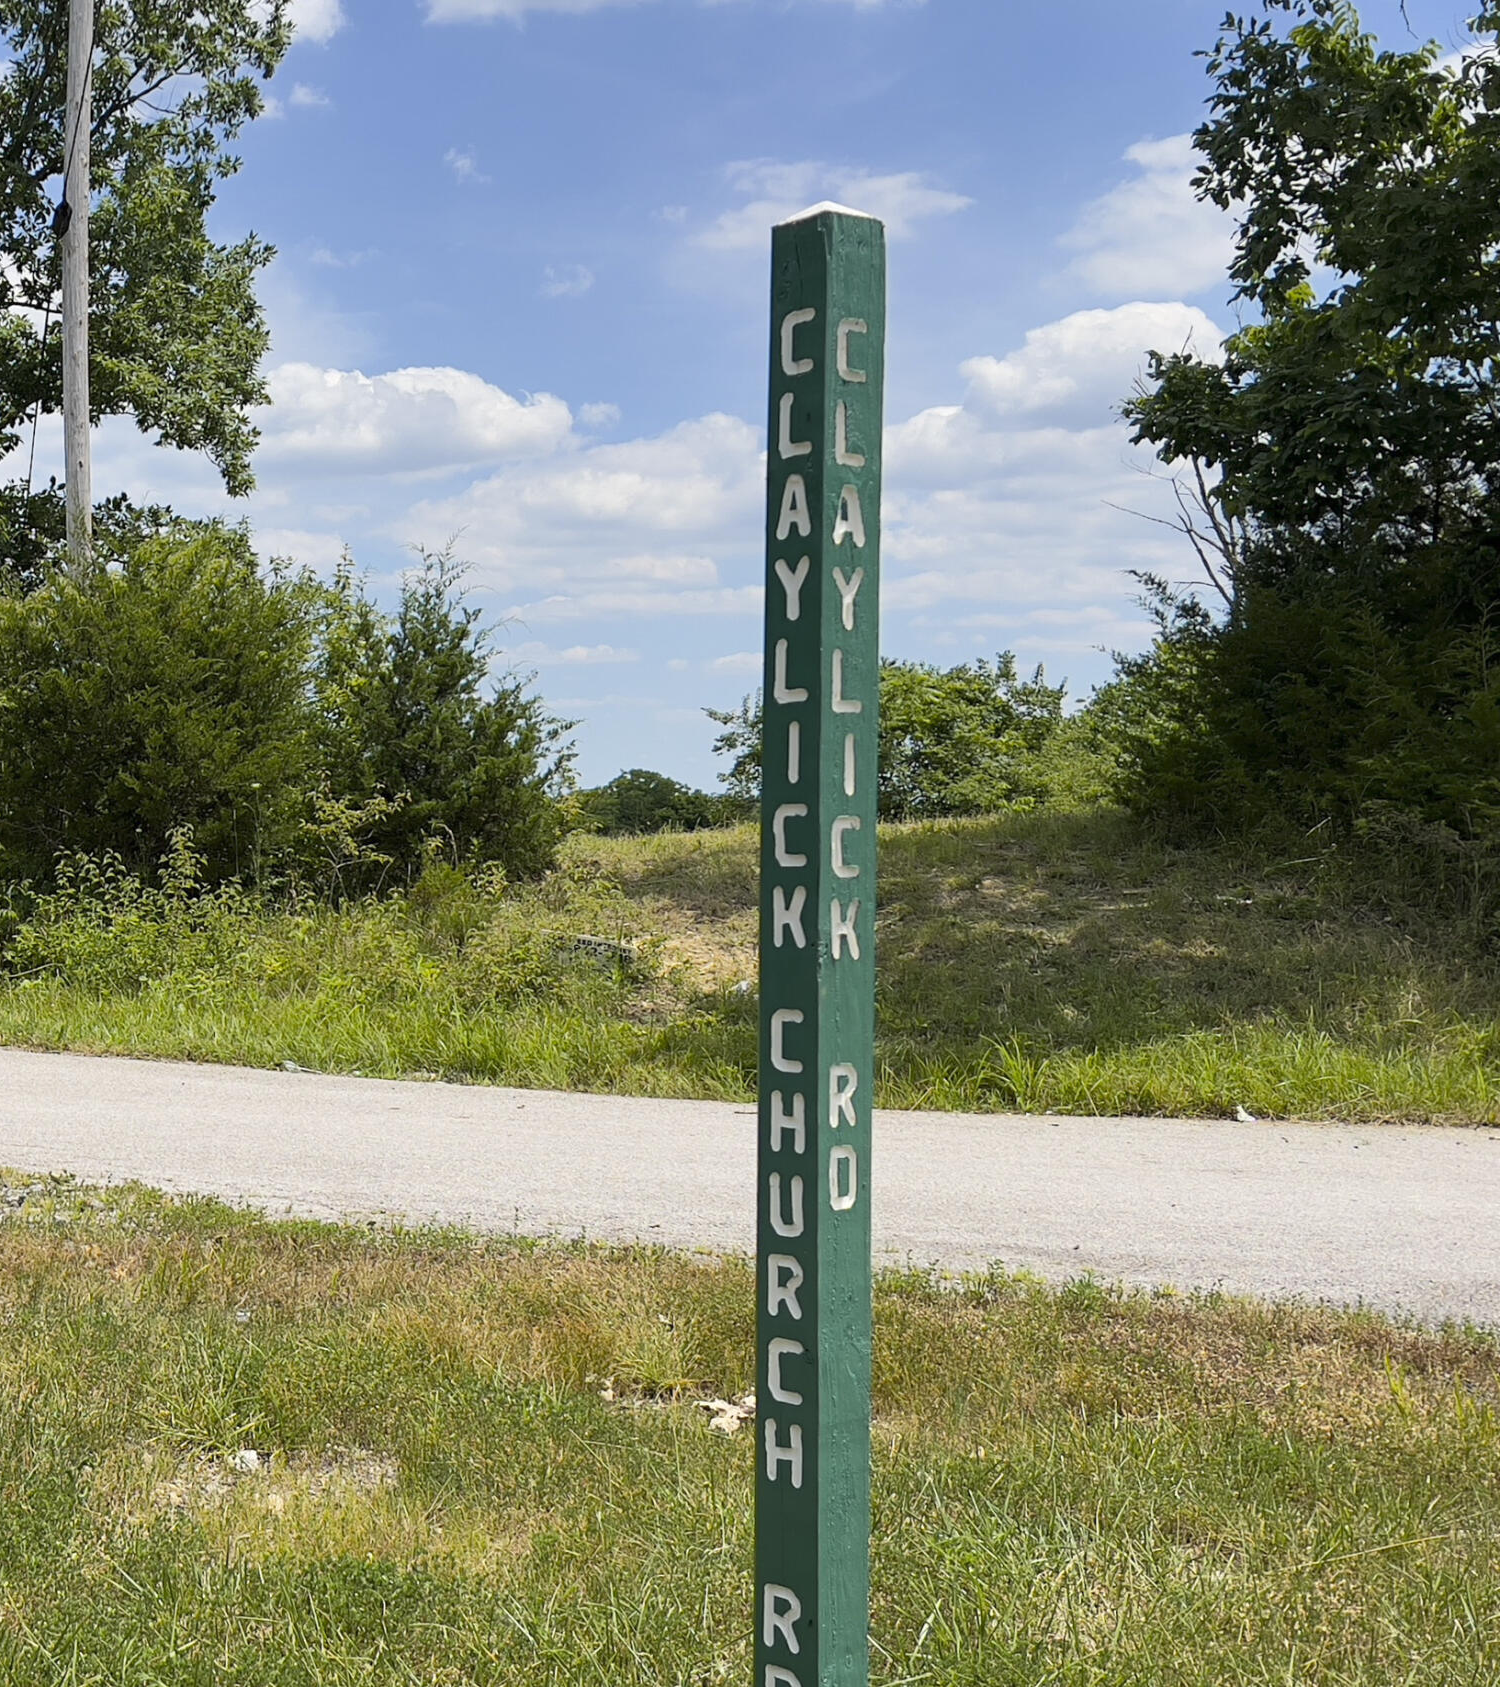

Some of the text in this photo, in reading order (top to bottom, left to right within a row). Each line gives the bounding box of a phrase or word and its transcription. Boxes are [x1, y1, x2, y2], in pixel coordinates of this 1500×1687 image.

[773, 309, 816, 949] CLAYLICK
[829, 317, 867, 962] CLAYLICK
[764, 1008, 805, 1490] CHURCH
